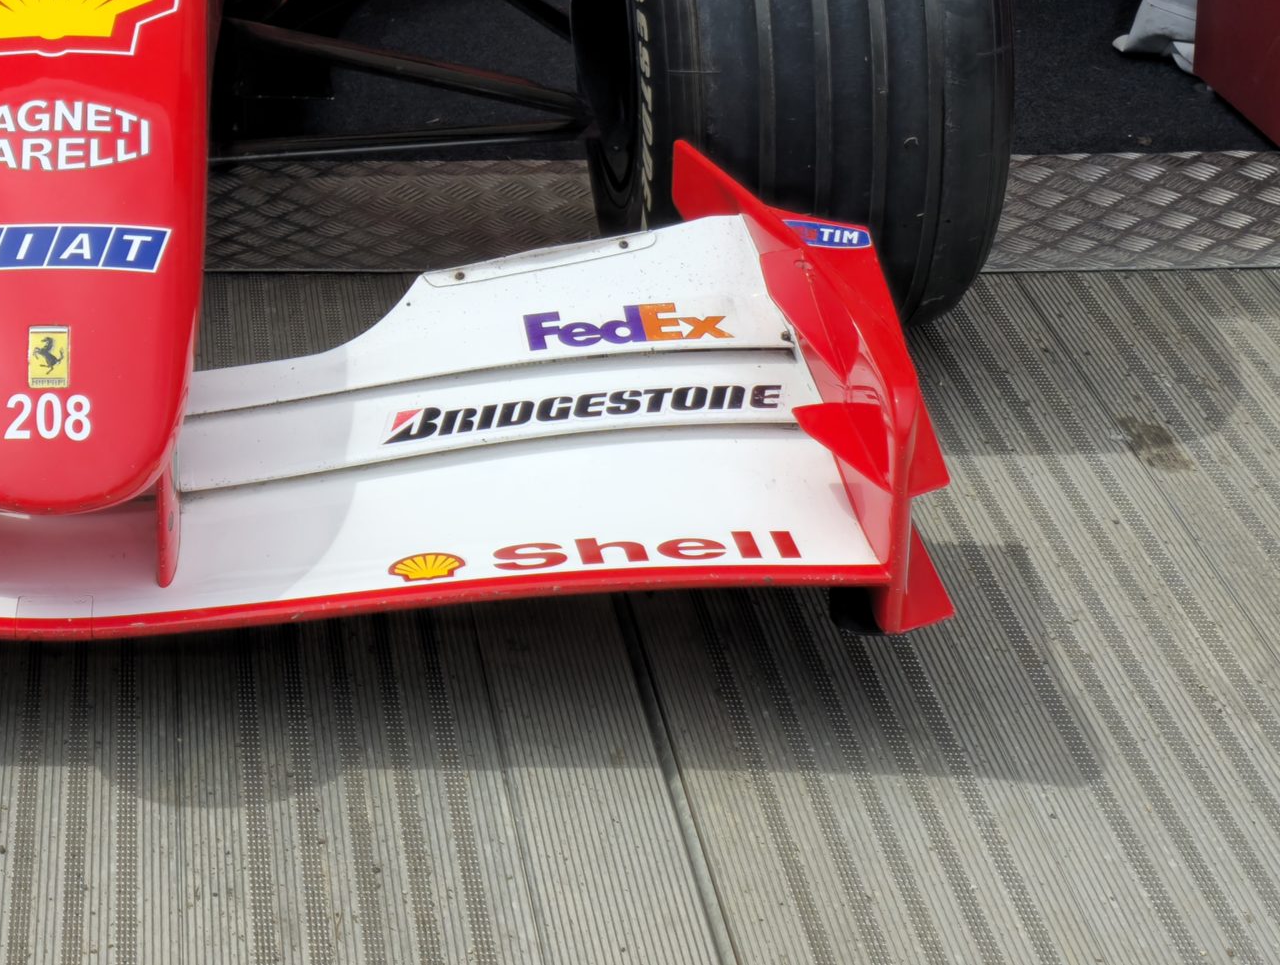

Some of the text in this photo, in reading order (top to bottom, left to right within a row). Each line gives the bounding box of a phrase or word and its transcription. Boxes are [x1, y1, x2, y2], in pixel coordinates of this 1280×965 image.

[819, 228, 860, 244] TIM
[523, 302, 734, 351] FedEx
[4, 392, 91, 441] 208
[382, 385, 782, 444] BRIDGESTONE
[493, 531, 802, 571] Shell
